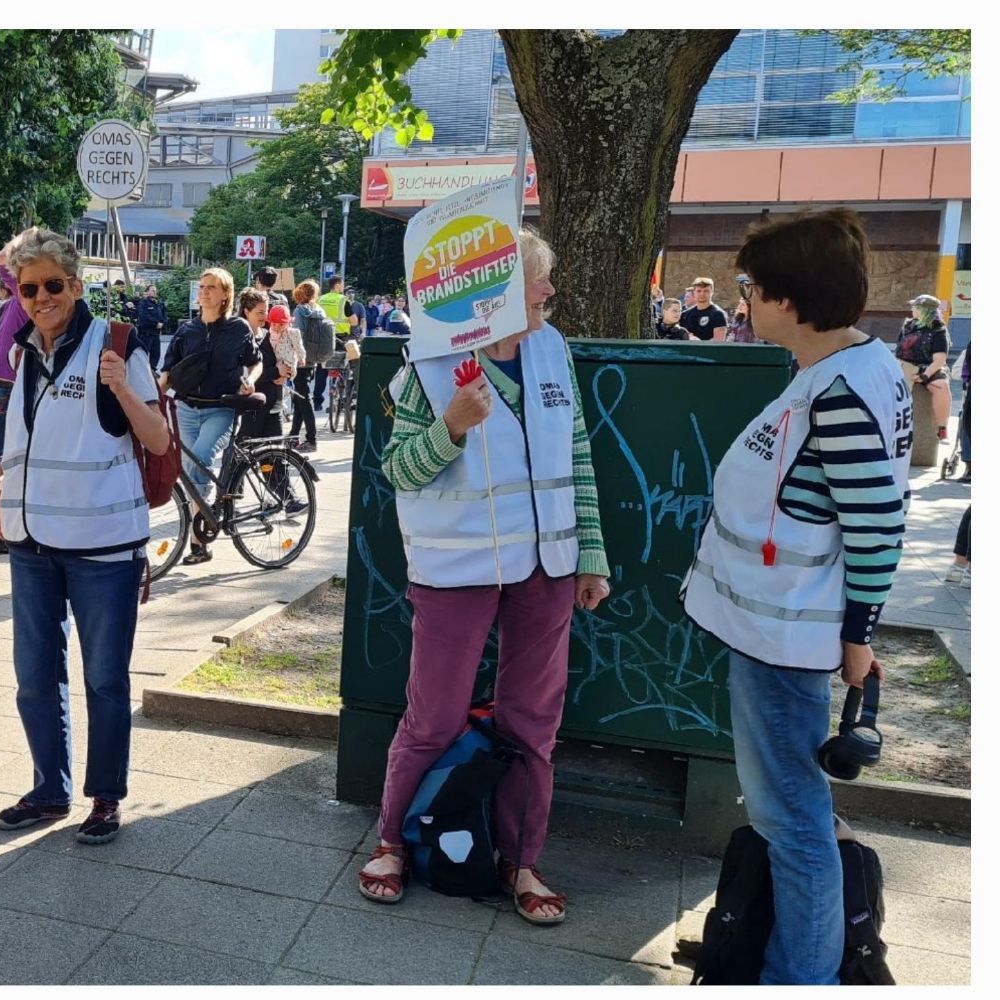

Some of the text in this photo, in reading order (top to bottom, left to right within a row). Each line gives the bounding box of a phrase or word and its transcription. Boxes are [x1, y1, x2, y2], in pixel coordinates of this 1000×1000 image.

[92, 132, 131, 146] OMAS
[88, 151, 133, 166] GEGEN
[87, 170, 136, 185] RECHTS
[422, 219, 497, 270] STOPPT
[416, 252, 518, 305] BRANDSTIFTER
[438, 261, 457, 280] DIE
